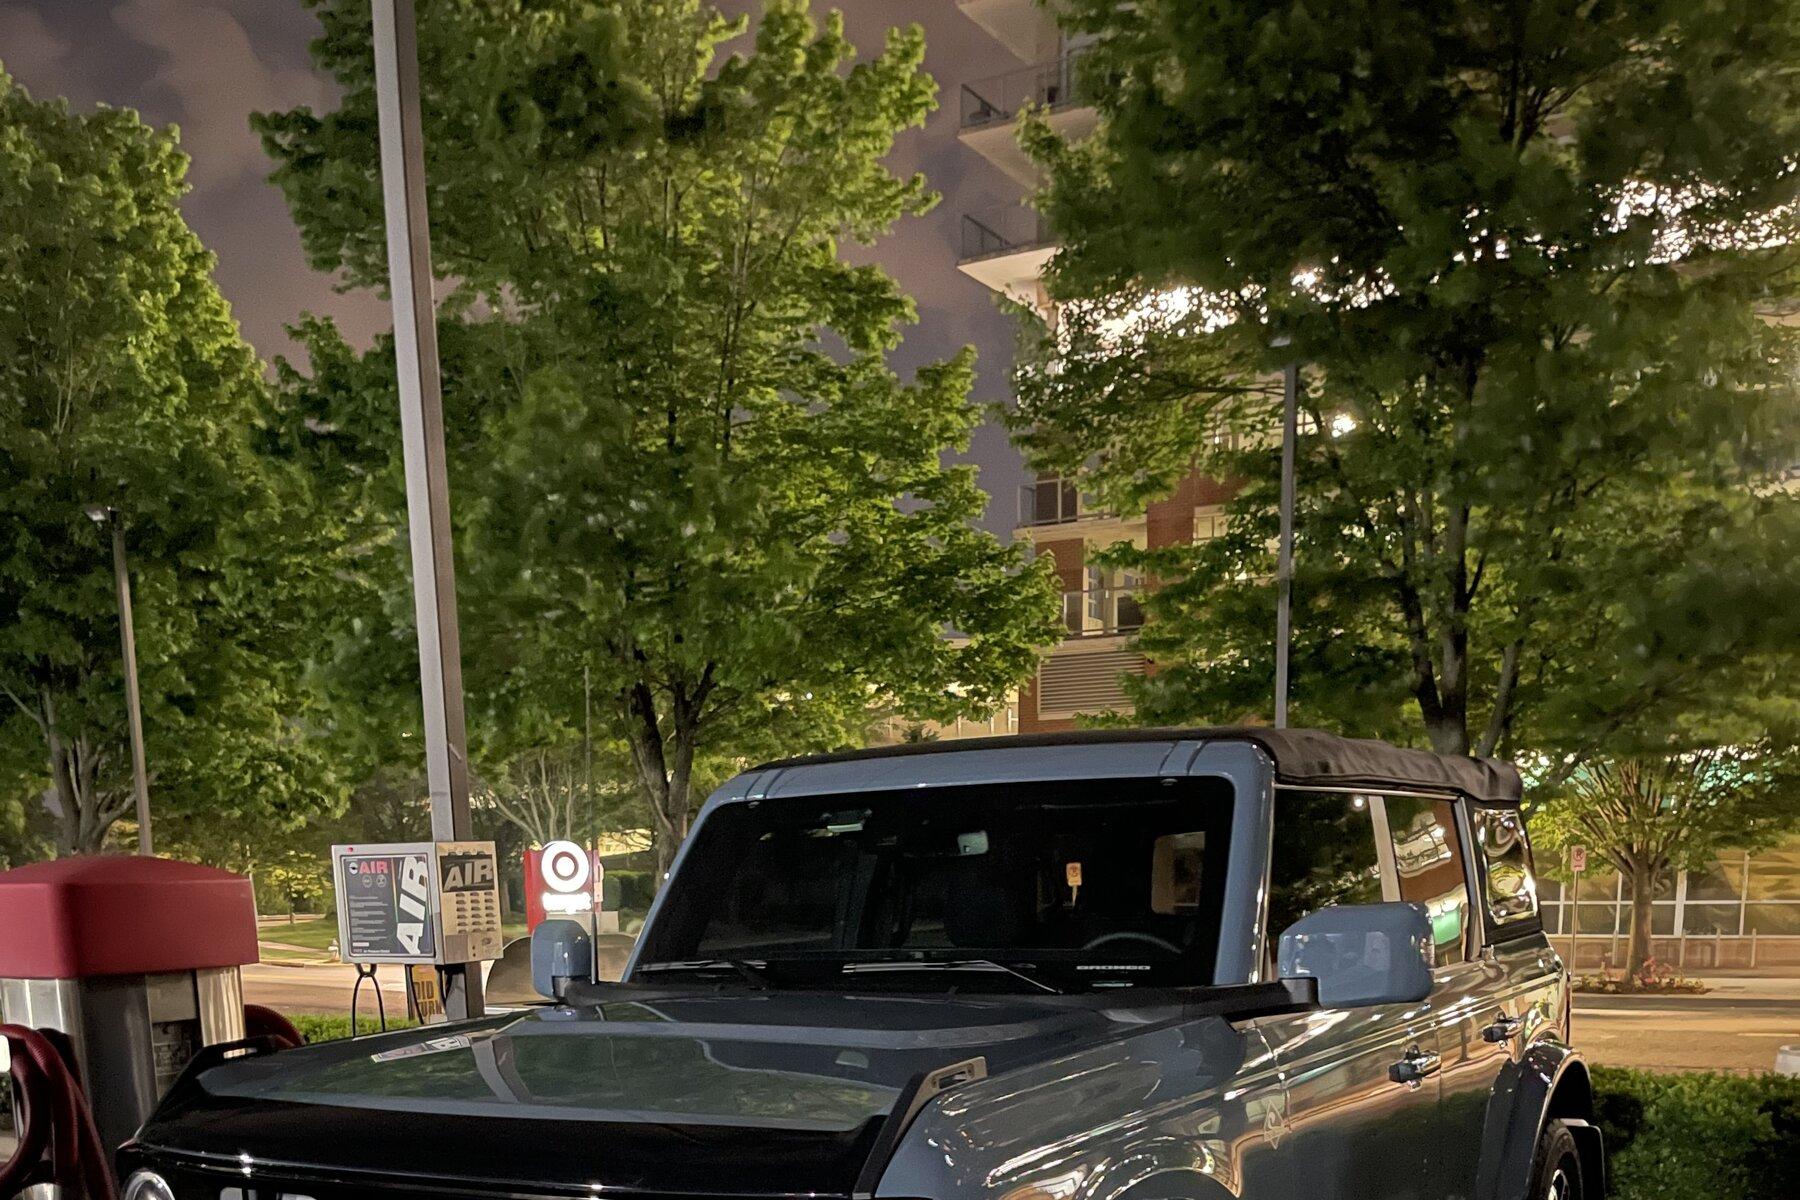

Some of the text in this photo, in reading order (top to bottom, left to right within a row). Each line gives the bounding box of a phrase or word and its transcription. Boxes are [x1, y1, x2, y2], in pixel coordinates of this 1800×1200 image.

[359, 860, 388, 874] AIR
[443, 858, 493, 892] AIR
[396, 856, 428, 955] AIR
